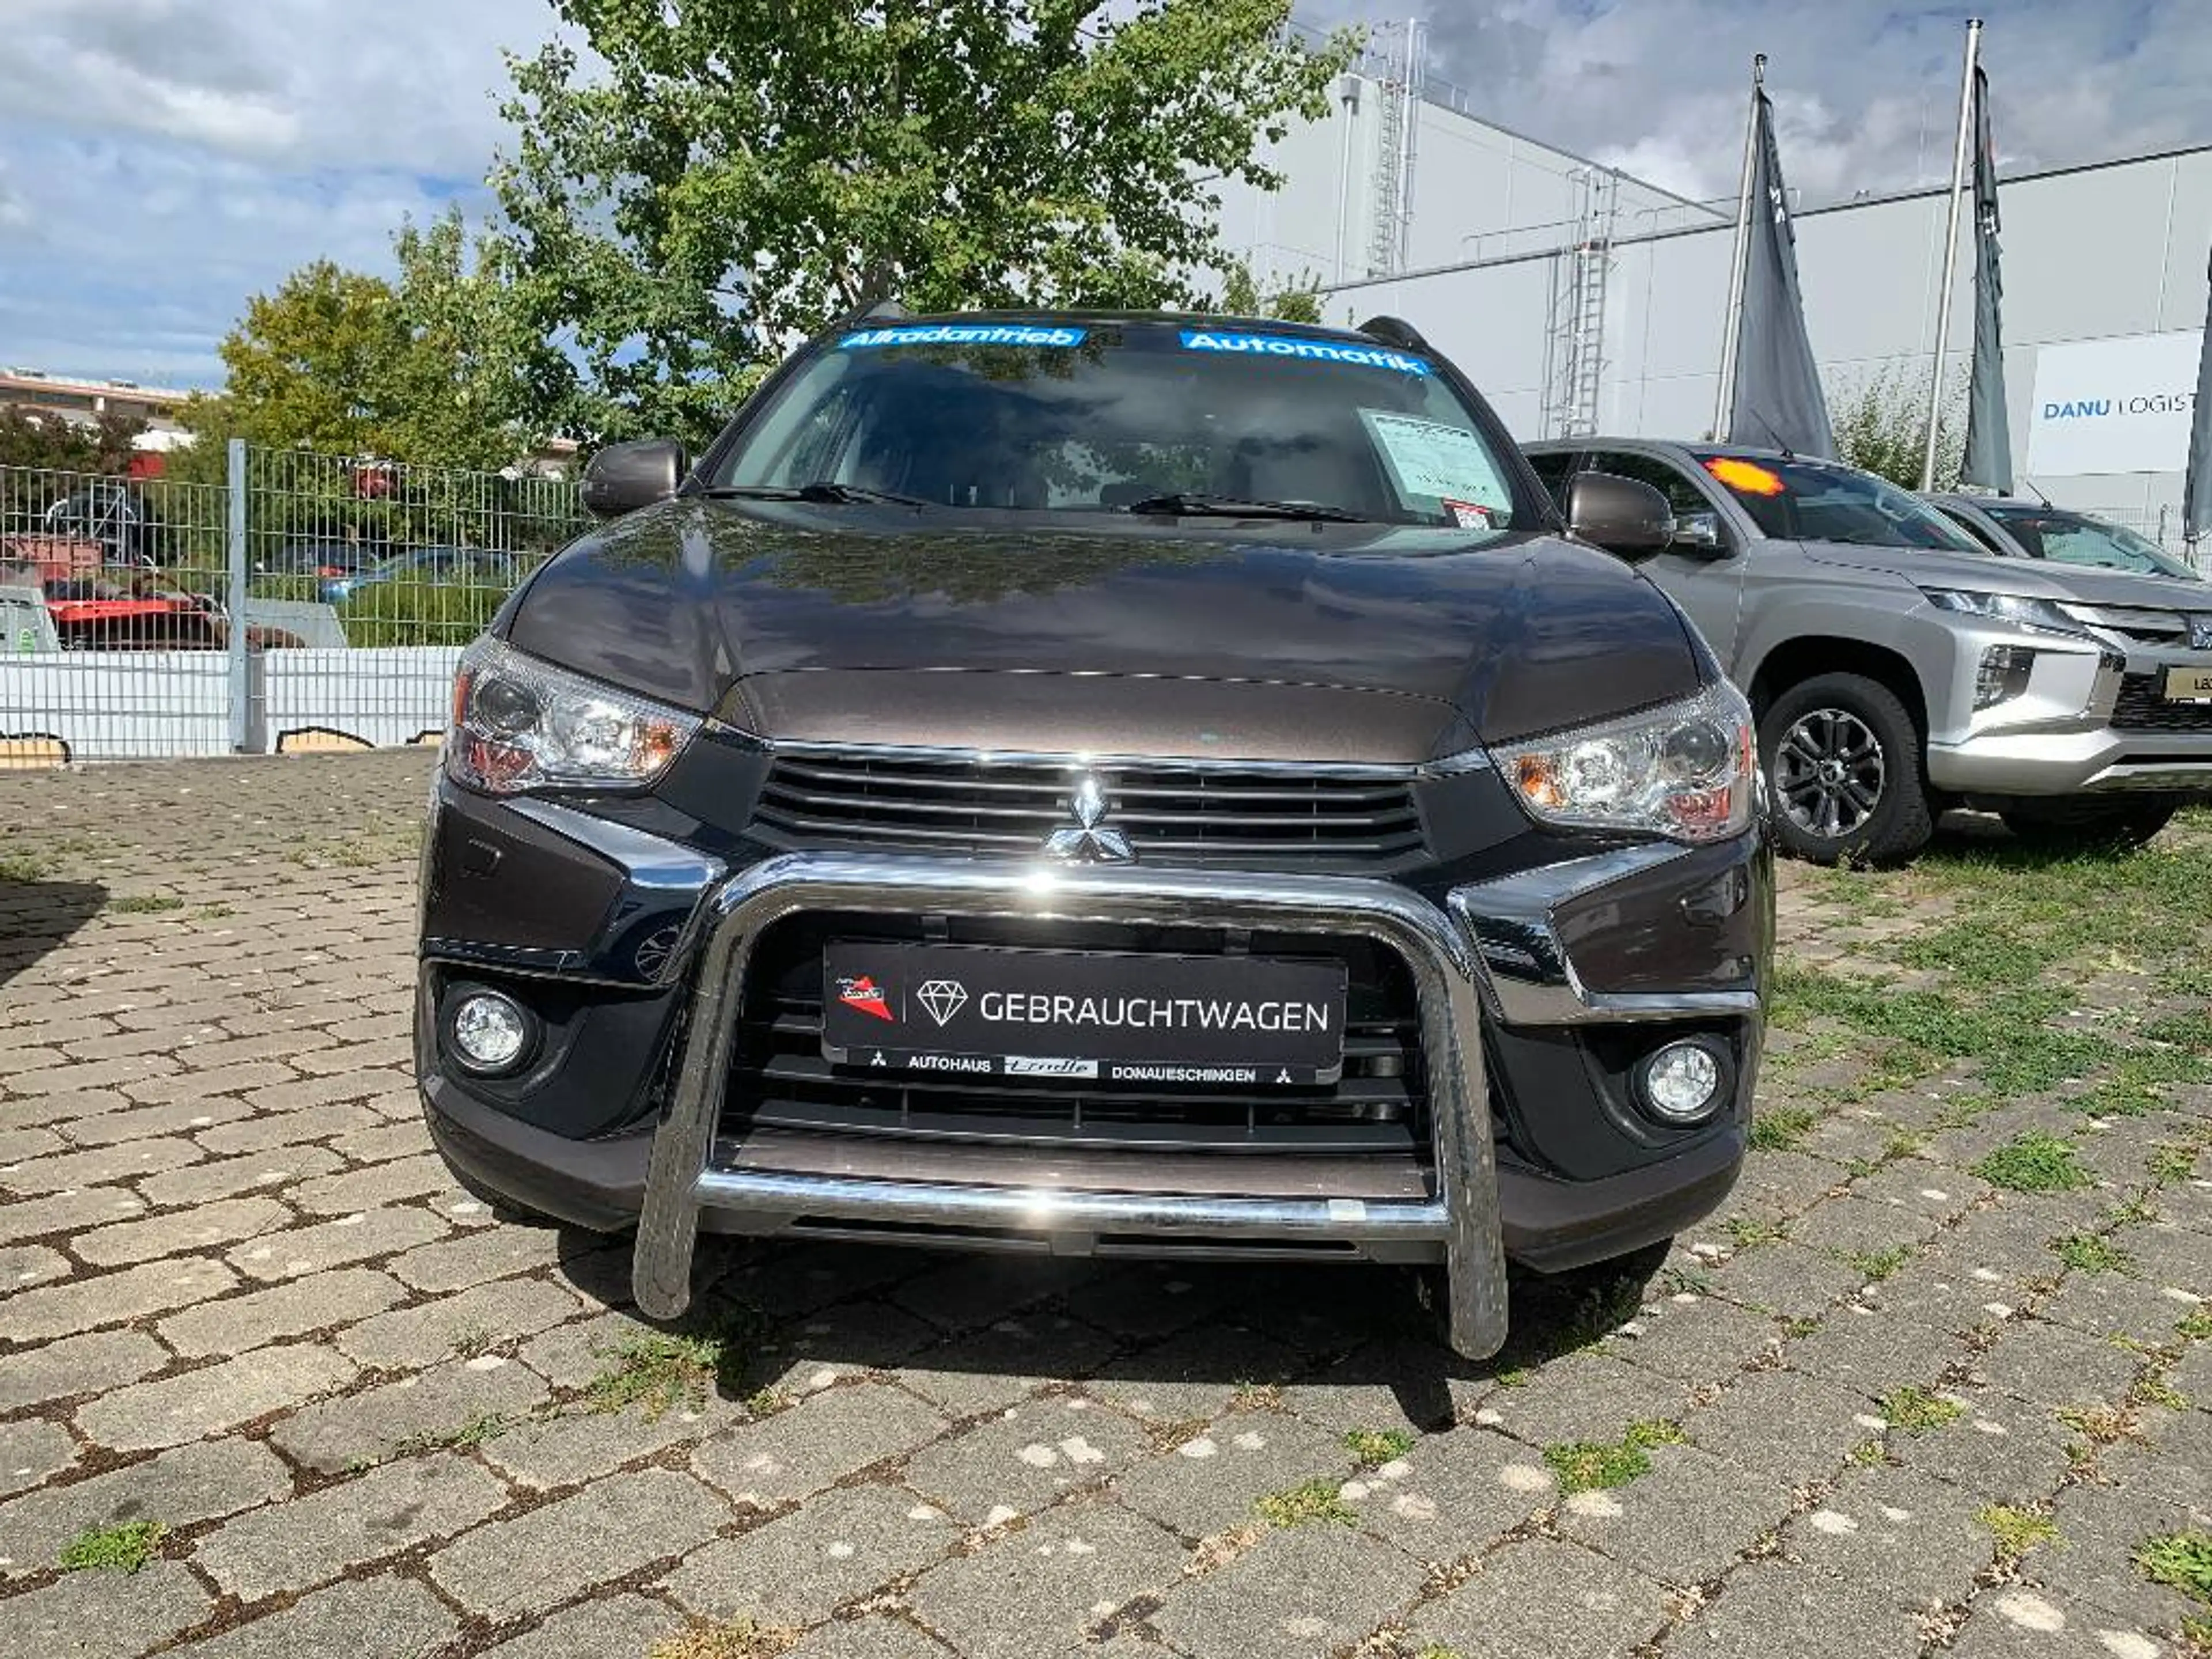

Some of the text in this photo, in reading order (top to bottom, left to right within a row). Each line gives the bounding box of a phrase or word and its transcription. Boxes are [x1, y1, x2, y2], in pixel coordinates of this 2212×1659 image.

[844, 327, 1073, 346] Allradantrieb
[1188, 334, 1427, 375] Automatik
[2044, 400, 2110, 419] DANU
[980, 992, 1328, 1031] GEBRAUCHTWAGEN
[908, 1056, 991, 1071] AUTOHAUS
[1112, 1066, 1256, 1082] DONAUESCHINGEN
